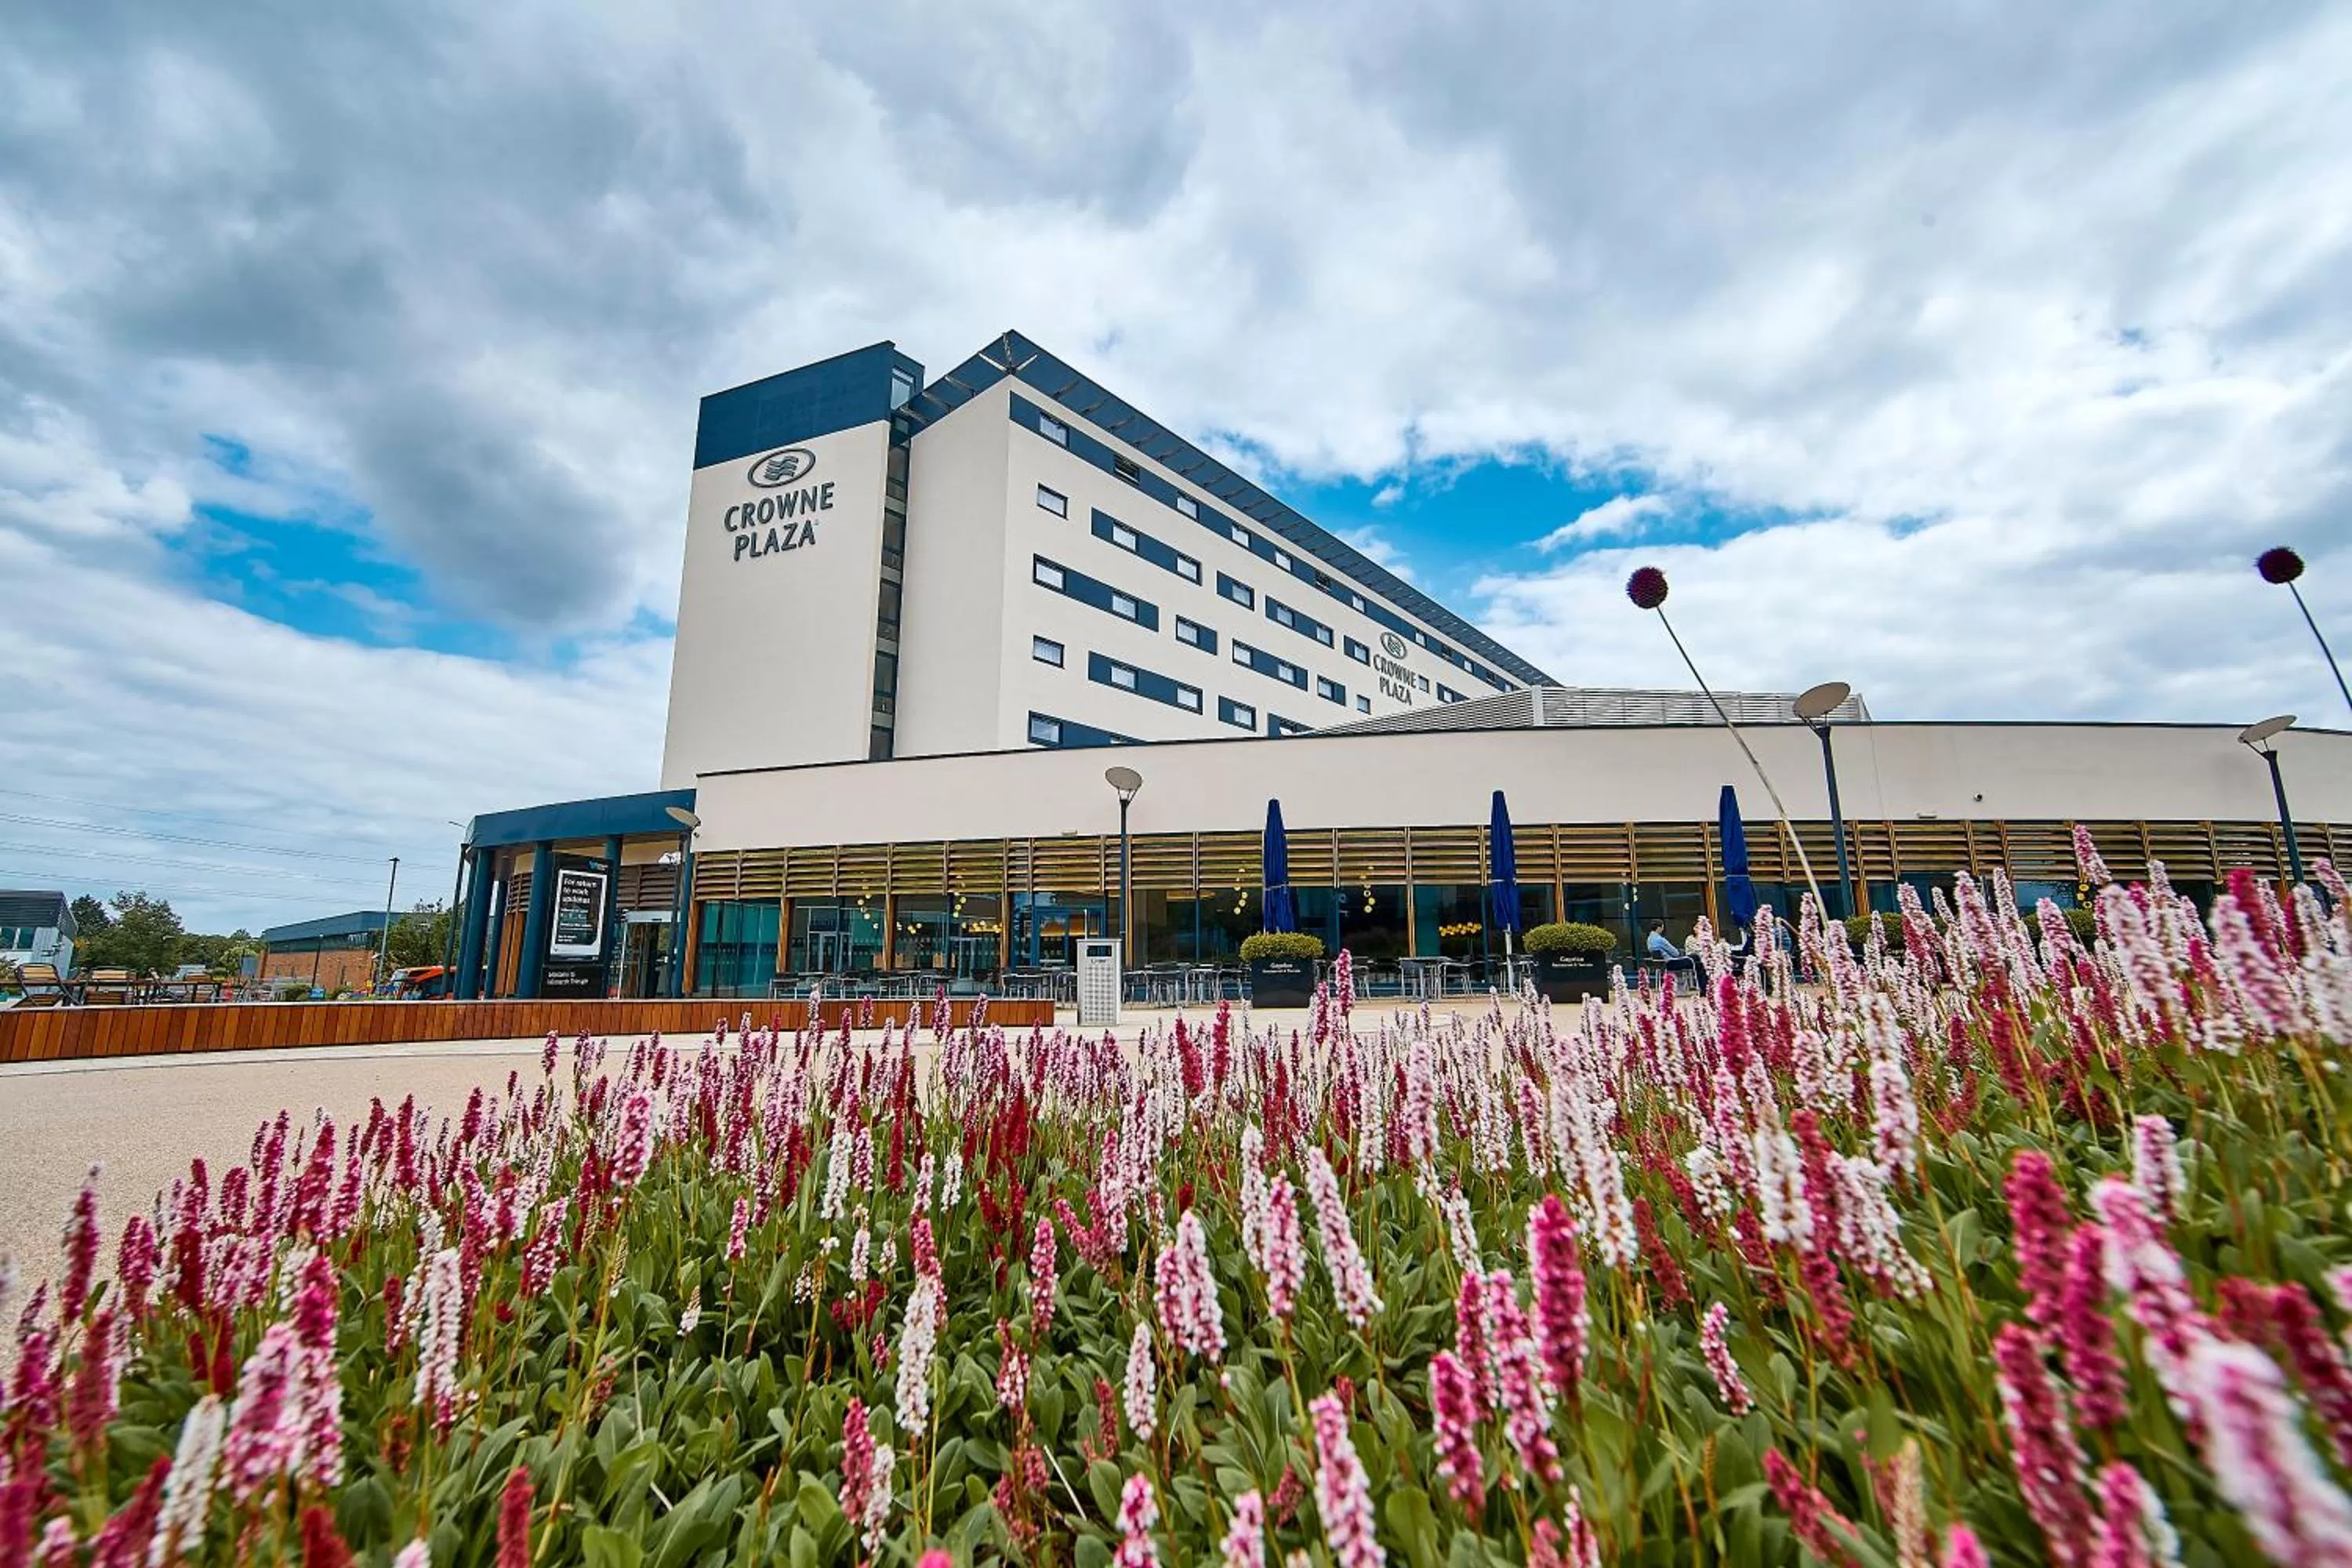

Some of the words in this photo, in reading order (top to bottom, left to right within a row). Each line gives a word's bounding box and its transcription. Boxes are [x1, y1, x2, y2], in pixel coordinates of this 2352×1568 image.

[724, 481, 835, 532] CROWNE
[734, 520, 816, 561] PLAZA
[1374, 654, 1417, 688] CROWNE
[1380, 677, 1413, 706] PLAZA
